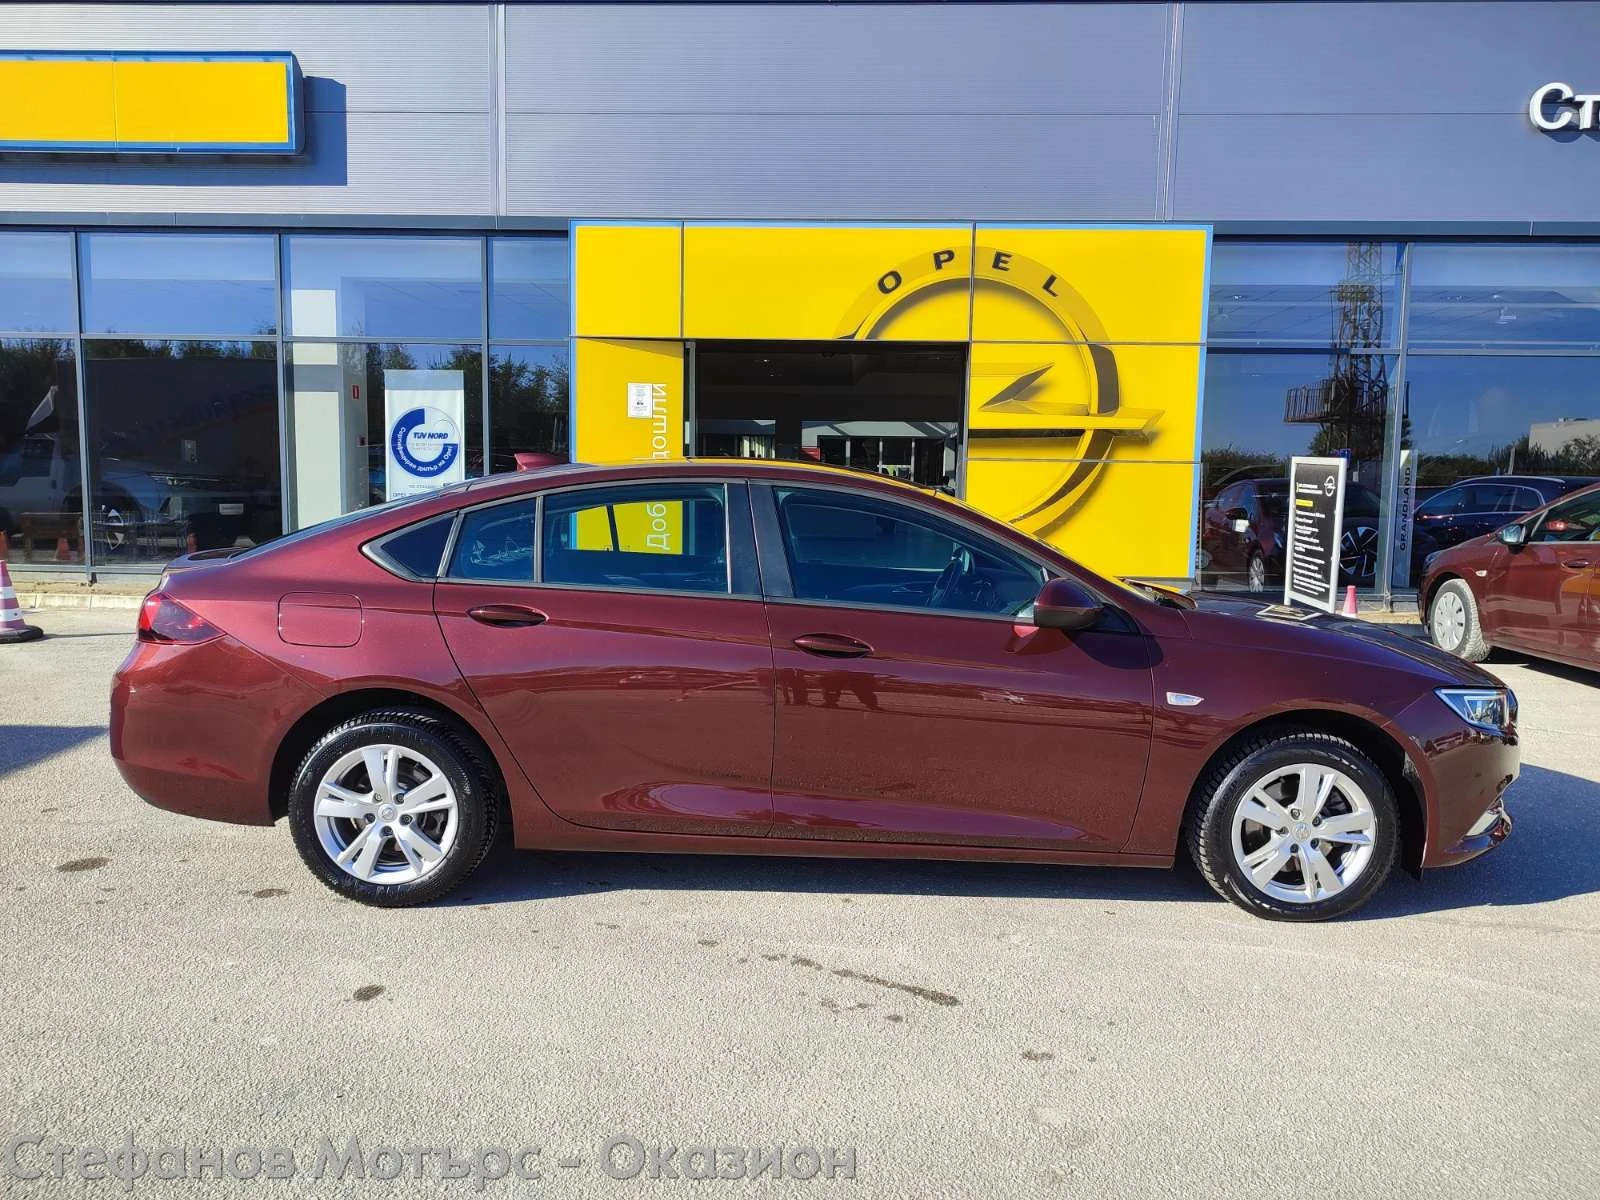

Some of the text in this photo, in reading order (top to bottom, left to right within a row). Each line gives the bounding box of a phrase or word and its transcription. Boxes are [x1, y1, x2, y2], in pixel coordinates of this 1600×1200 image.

[1529, 82, 1600, 130] Ст
[877, 249, 1059, 297] OPEL
[1400, 467, 1411, 551] GRANDLAND
